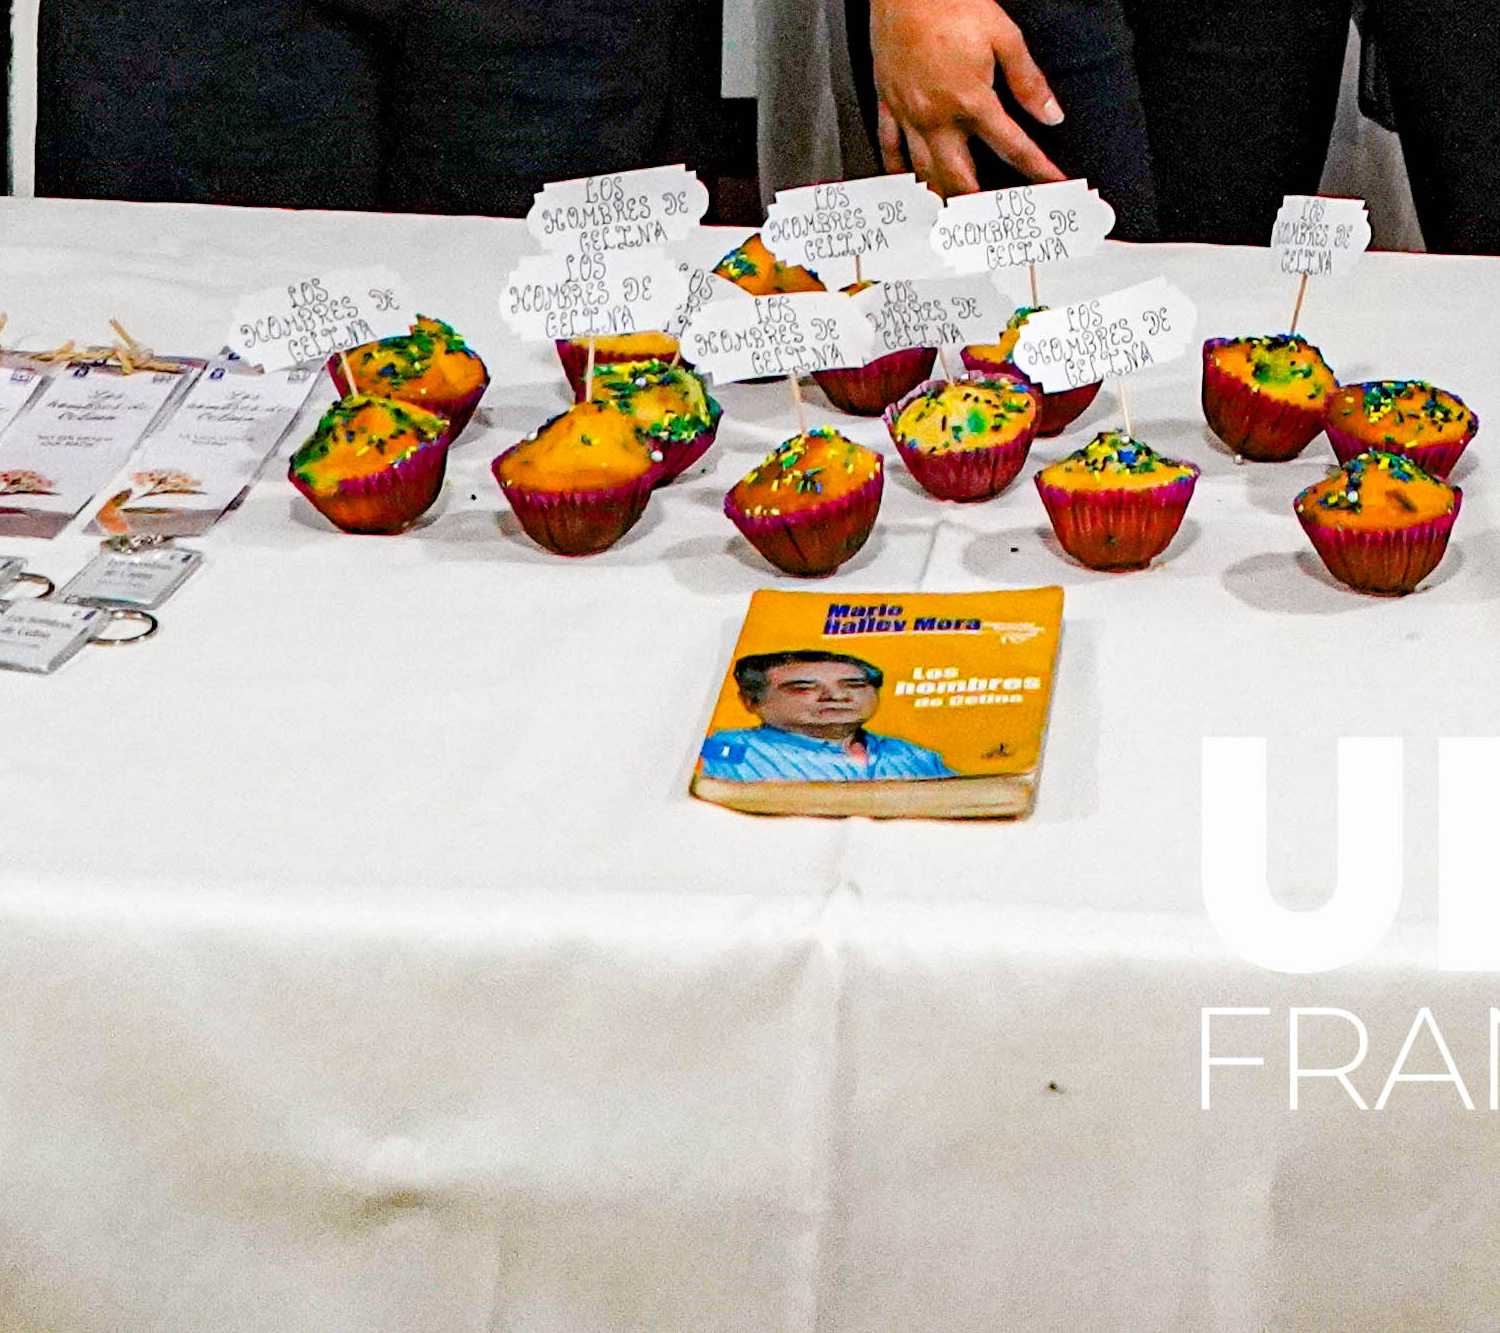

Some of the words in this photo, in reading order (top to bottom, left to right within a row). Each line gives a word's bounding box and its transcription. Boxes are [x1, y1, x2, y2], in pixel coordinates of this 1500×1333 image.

[585, 176, 624, 204] LOS
[814, 183, 850, 210] LOS
[996, 186, 1036, 219] LOS
[565, 253, 607, 283] LOS
[288, 277, 329, 308] LOS
[754, 296, 796, 324] LOS
[1067, 300, 1102, 333] LOS
[828, 604, 904, 618] Mario
[912, 617, 982, 632] Mora
[894, 677, 1042, 696] hombres
[912, 667, 960, 681] Los
